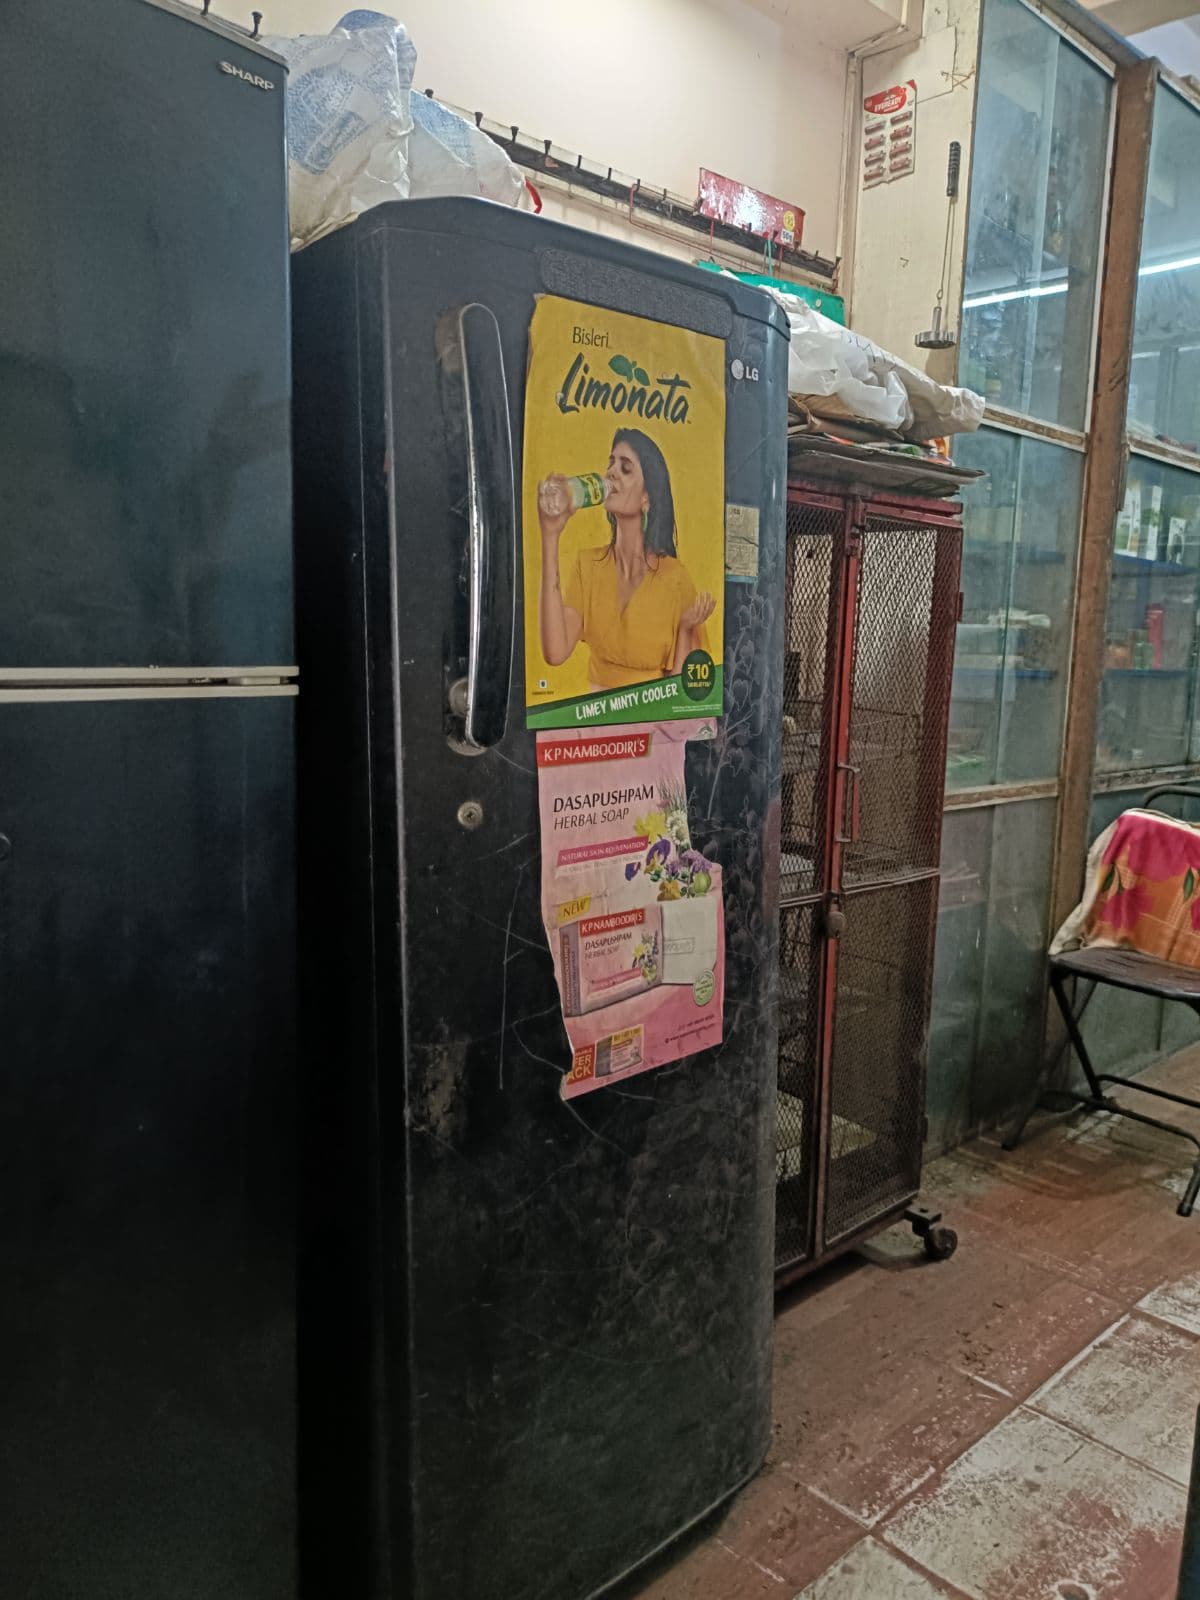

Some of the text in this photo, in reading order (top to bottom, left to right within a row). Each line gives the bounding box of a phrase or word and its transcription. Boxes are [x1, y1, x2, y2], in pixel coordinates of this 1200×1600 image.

[220, 61, 275, 90] SHARP
[572, 326, 609, 348] Bisleri
[745, 366, 759, 381] LG
[558, 352, 691, 424] Limonata
[575, 683, 679, 720] LIMEY MINTY COOLER
[553, 784, 654, 812] DASAPUSHPAM
[554, 807, 630, 831] HERBAL SOAP
[563, 900, 587, 920] NEW
